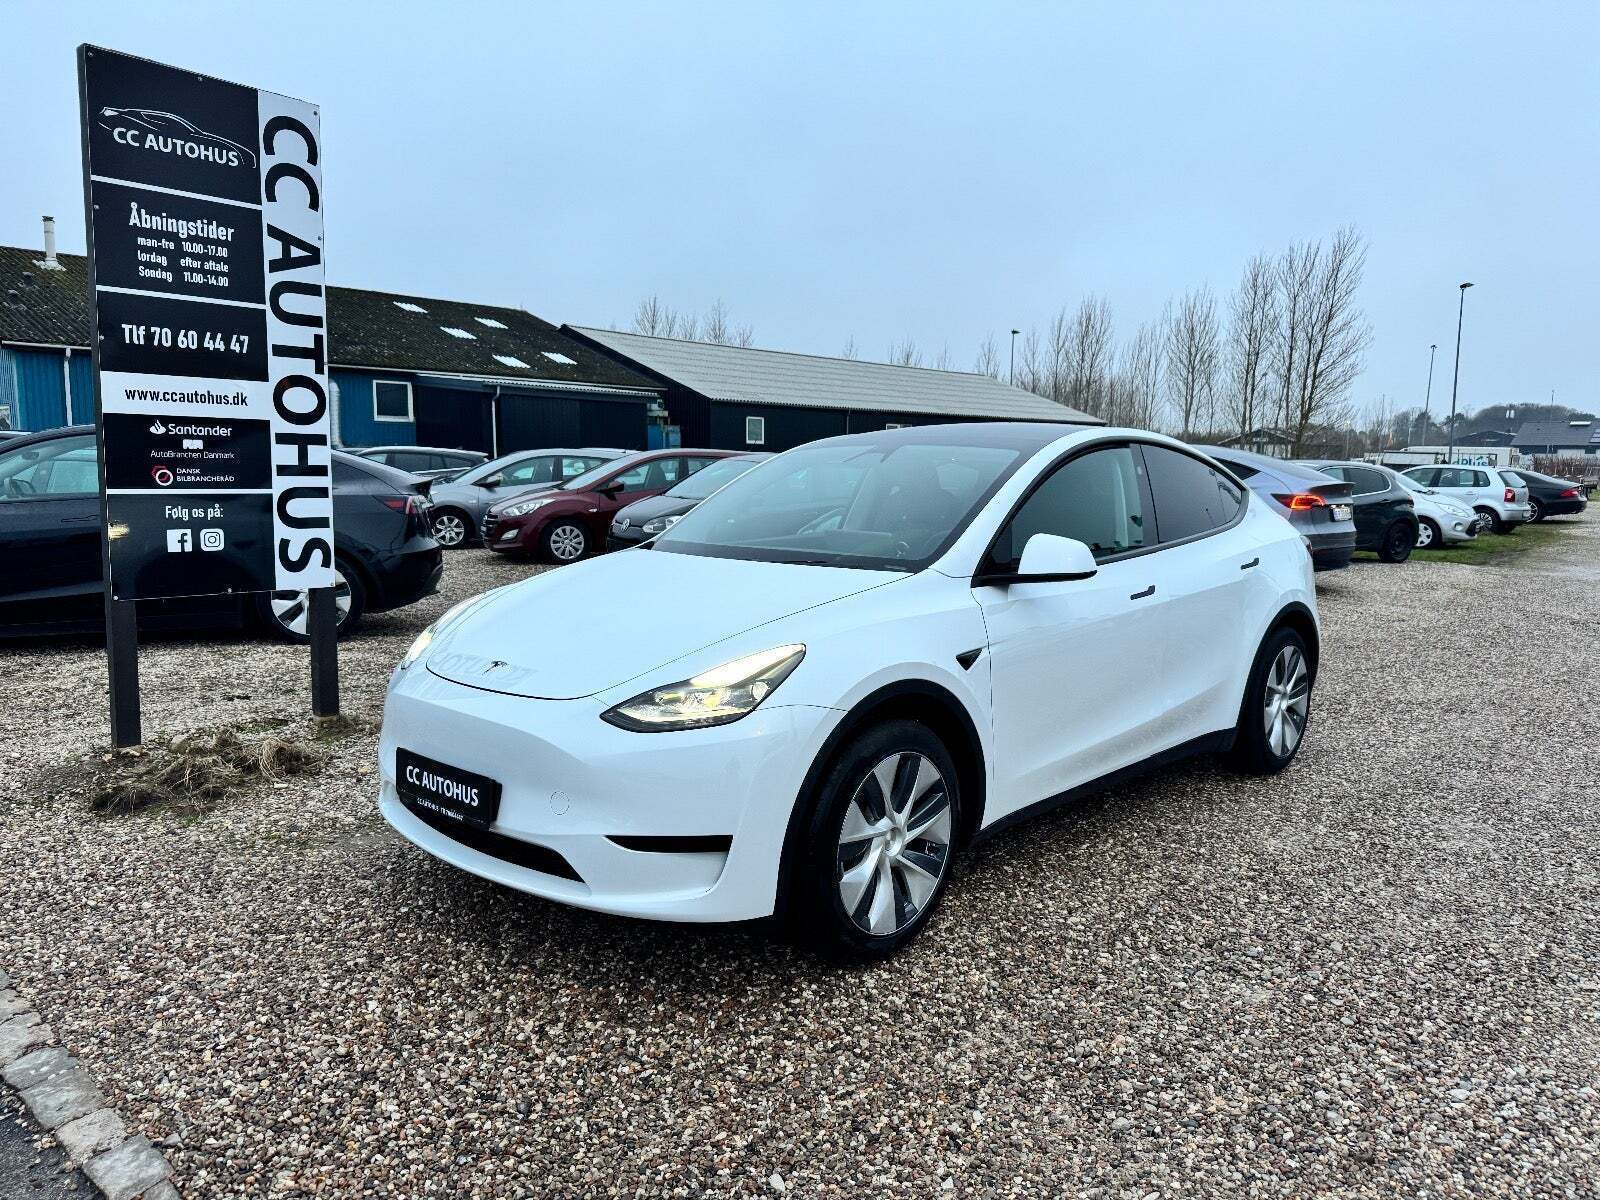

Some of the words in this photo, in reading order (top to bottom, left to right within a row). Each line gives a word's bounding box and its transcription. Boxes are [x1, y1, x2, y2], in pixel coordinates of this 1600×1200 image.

[112, 127, 140, 147] CC
[144, 133, 239, 167] AUTOHUS
[263, 115, 320, 213] CC
[129, 201, 235, 241] Åbningstider
[137, 236, 175, 250] man-fre
[181, 241, 228, 258] 10.00-17.00
[180, 256, 202, 269] efter
[203, 260, 229, 273] aftale
[183, 271, 229, 287] 11.00-14.00
[121, 323, 146, 345] Tlf
[150, 326, 172, 348] 70
[177, 329, 198, 350] 60
[203, 331, 226, 352] 44
[229, 334, 249, 354] 47
[124, 388, 249, 407] www.ccautohus.dk
[266, 222, 332, 573] AUTOHUS
[168, 423, 233, 437] Santander
[150, 449, 202, 459] AutoBranchen
[203, 451, 235, 460] Danmark
[176, 467, 201, 475] DANSK
[176, 474, 235, 482] BILBRANCHERÅD
[165, 505, 189, 521] Følg
[191, 508, 205, 518] os
[207, 503, 224, 521] på:
[406, 765, 420, 785] CC
[421, 771, 479, 807] AUTOHUS
